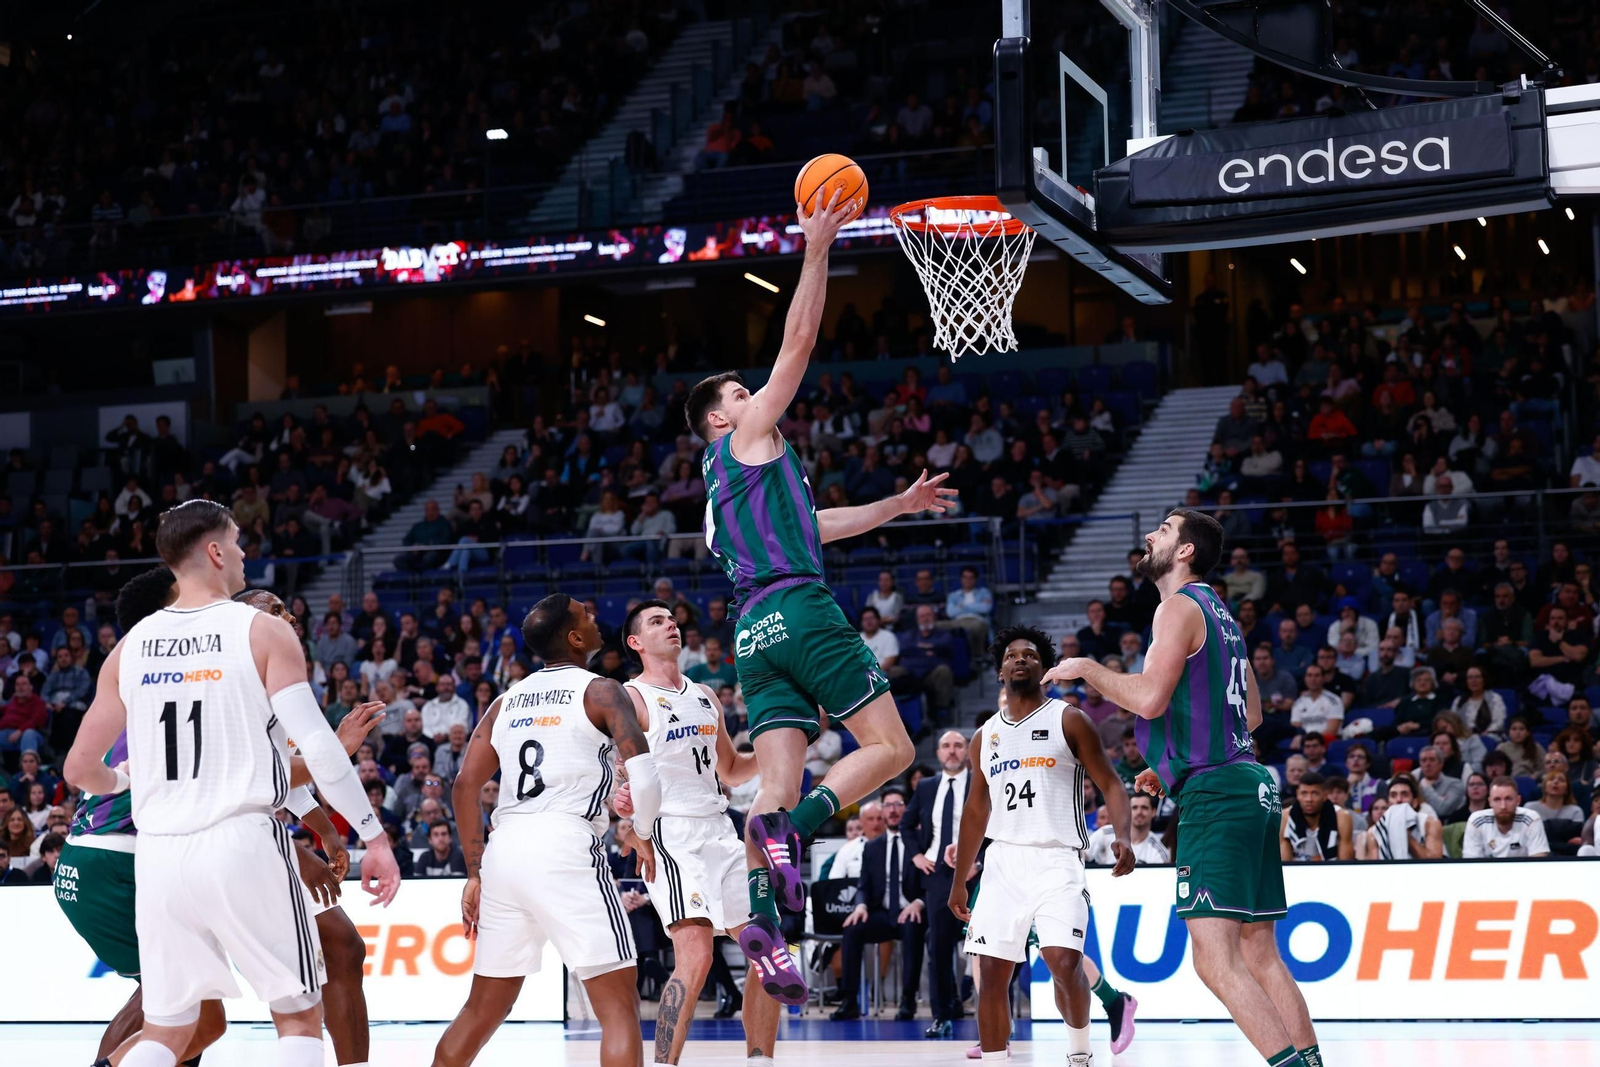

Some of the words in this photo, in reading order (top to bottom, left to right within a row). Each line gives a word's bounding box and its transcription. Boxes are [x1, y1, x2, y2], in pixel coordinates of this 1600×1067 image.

[1218, 137, 1450, 193] endesa
[751, 611, 784, 634] COSTA
[752, 631, 767, 643] DEL
[767, 623, 787, 636] SOL
[141, 634, 222, 658] HEZONJA
[141, 669, 222, 686] AUTOHERO
[509, 716, 561, 730] UTOHERO
[666, 725, 717, 742] AUTOHER
[159, 700, 202, 781] 11
[517, 739, 545, 801] 8
[692, 745, 711, 775] 14
[990, 756, 1056, 777] AUTOHERO
[1005, 780, 1036, 811] 24
[58, 863, 79, 880] STA
[60, 879, 78, 891] SOL
[57, 890, 78, 903] LAGA
